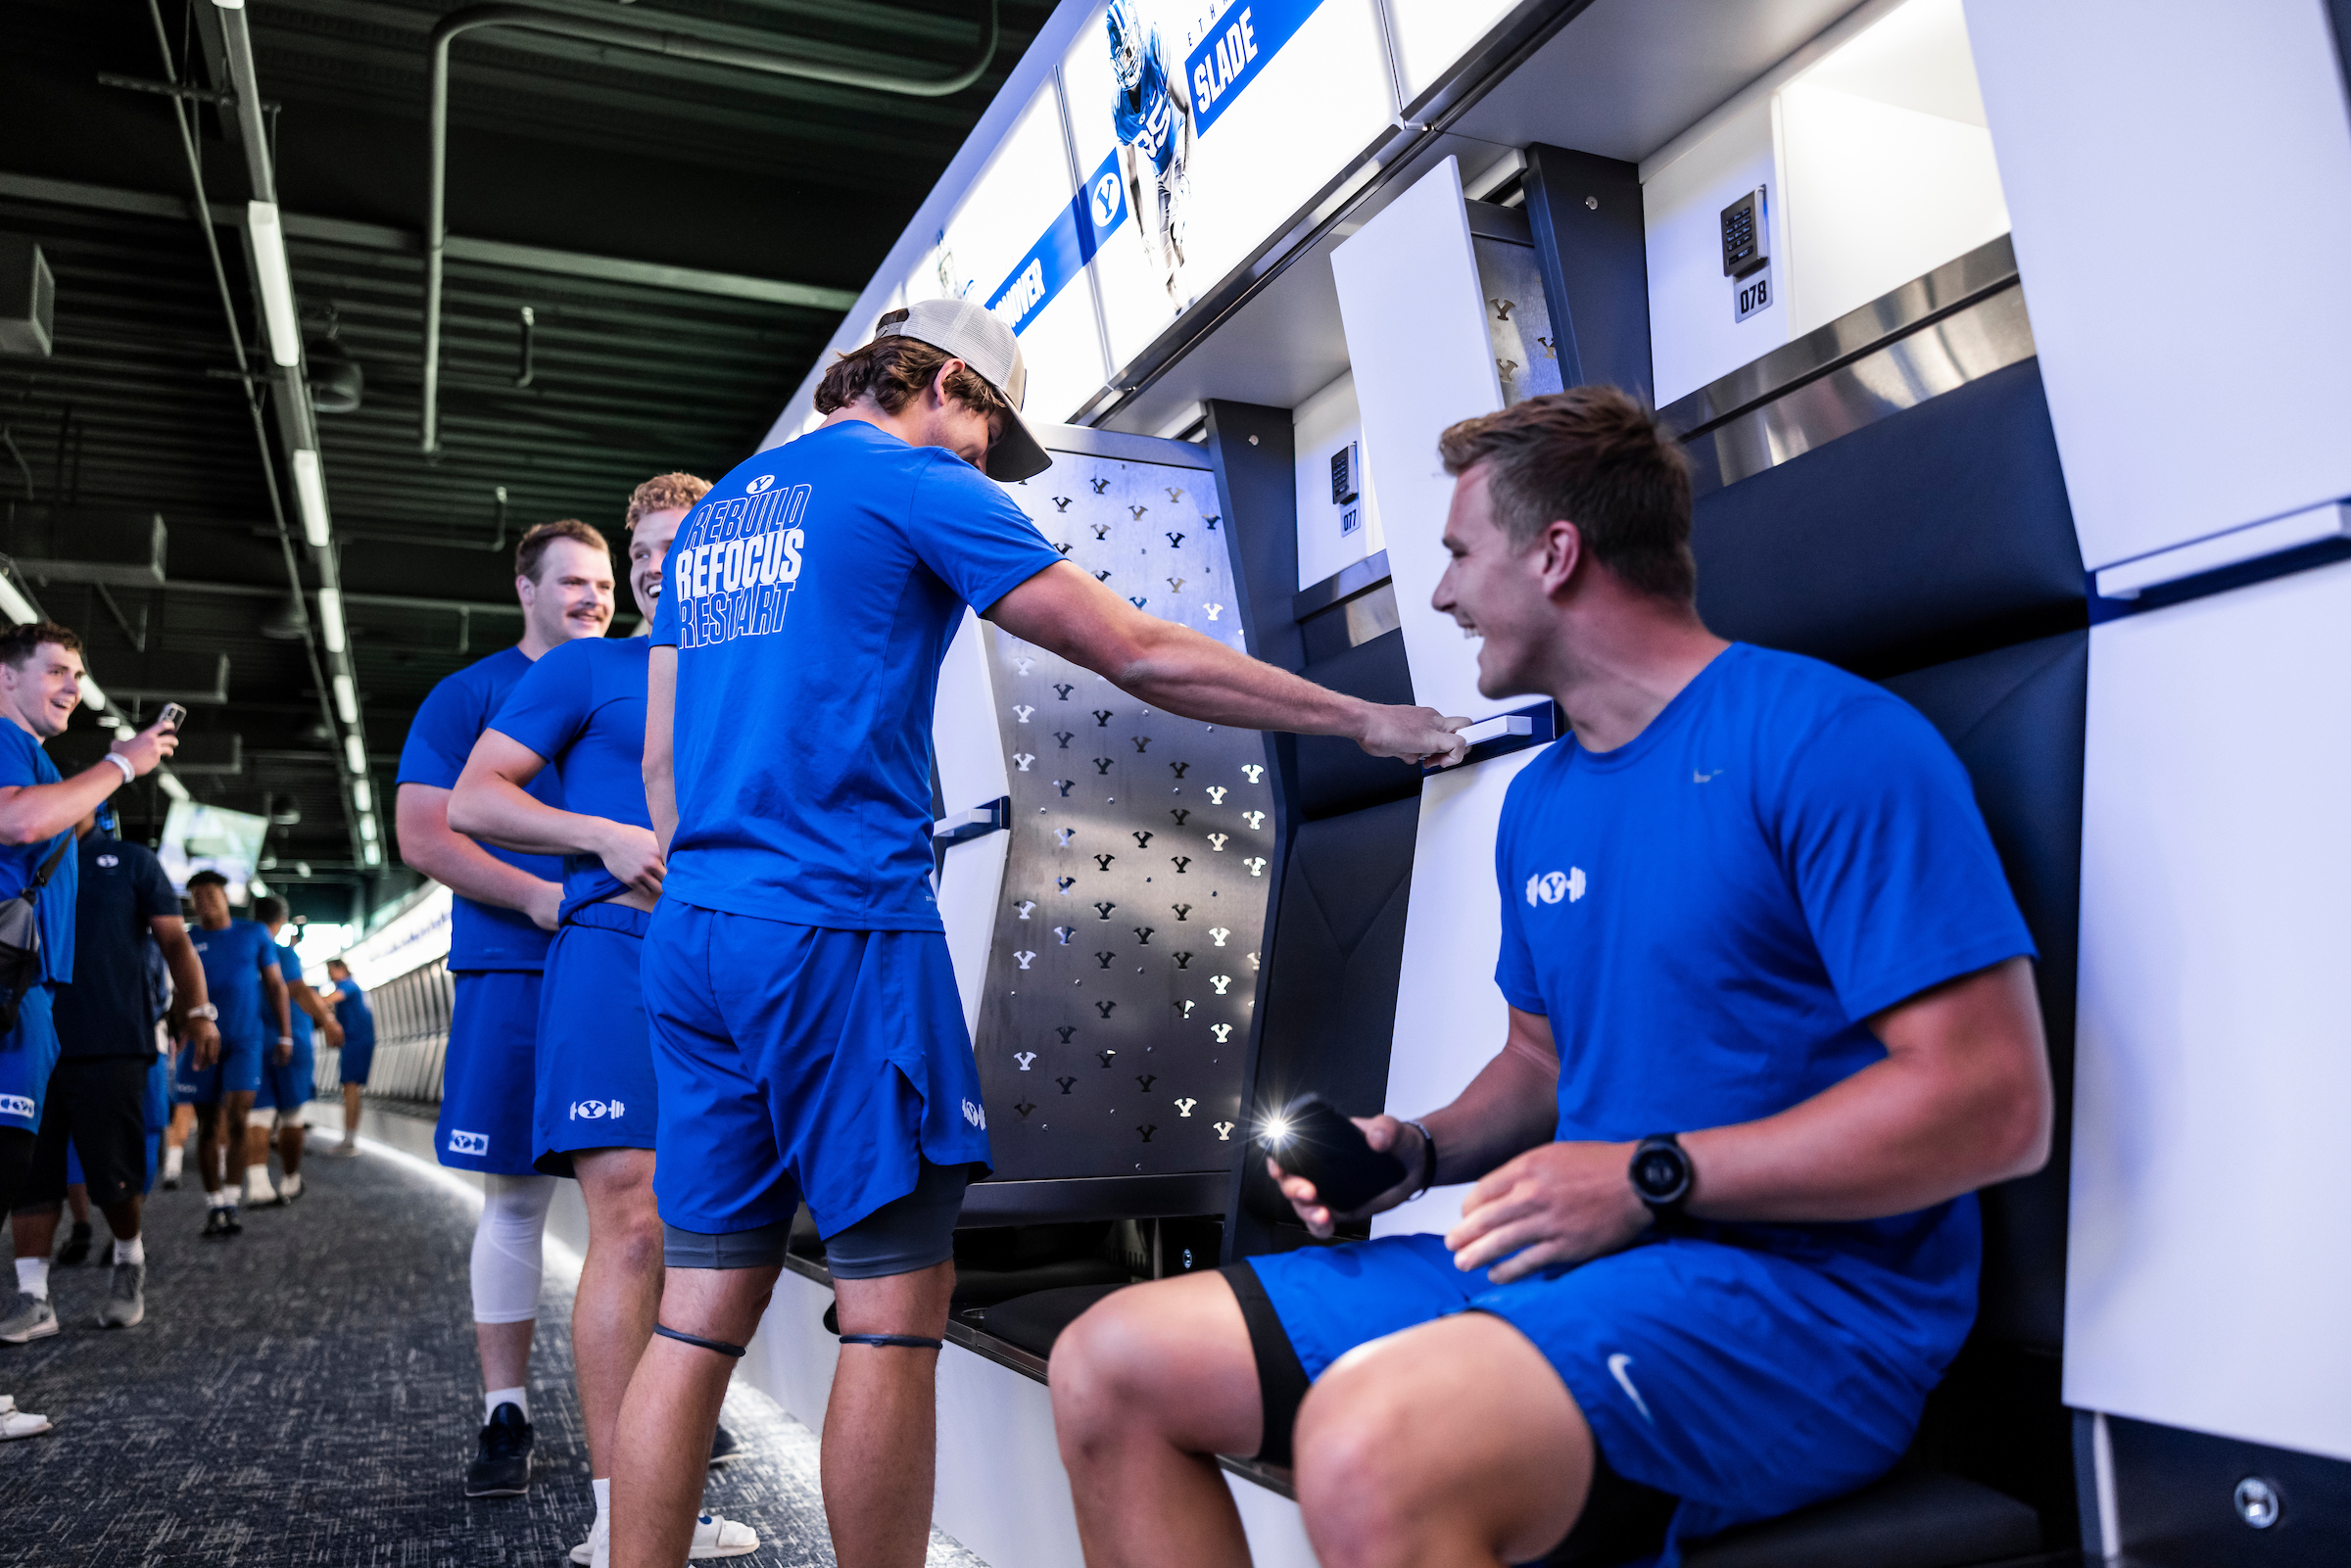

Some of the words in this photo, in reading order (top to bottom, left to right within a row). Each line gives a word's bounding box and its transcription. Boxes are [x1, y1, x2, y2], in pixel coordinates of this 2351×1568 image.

[1194, 6, 1259, 114] SLADE
[1096, 179, 1114, 219] Y
[1490, 298, 1515, 321] Y
[1740, 280, 1767, 314] 078
[683, 484, 812, 551] REBUILD
[1344, 508, 1357, 532] 077
[675, 529, 805, 602] REFOCUS
[679, 580, 796, 650] RESTART
[1546, 877, 1563, 900] Y
